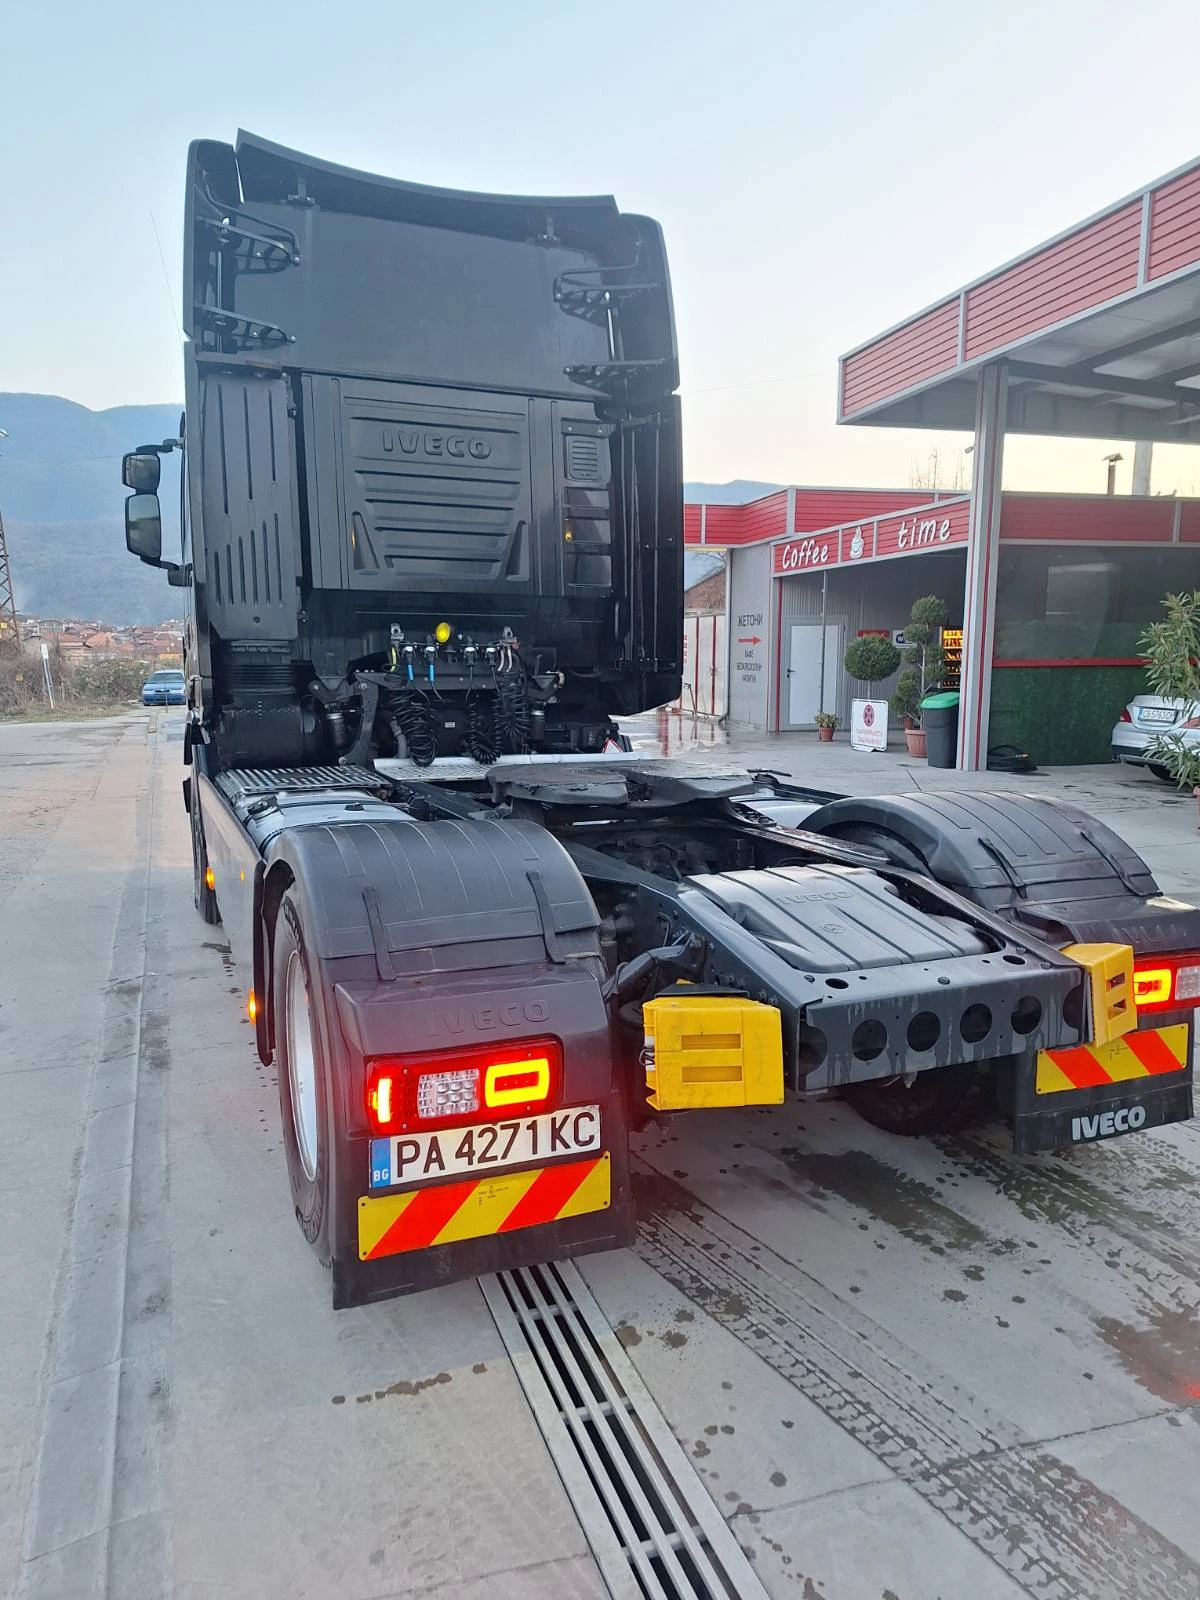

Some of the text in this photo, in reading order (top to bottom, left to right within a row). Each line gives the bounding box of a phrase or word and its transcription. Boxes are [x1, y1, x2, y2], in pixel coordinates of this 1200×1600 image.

[382, 429, 492, 460] IVECO
[782, 517, 951, 569] Coffee time
[737, 613, 763, 627] ЖЕТОНИ
[429, 1000, 551, 1037] IVECO
[1071, 1105, 1147, 1141] IVECO
[397, 1111, 595, 1178] PA 4271 KC
[373, 1168, 389, 1182] BG
